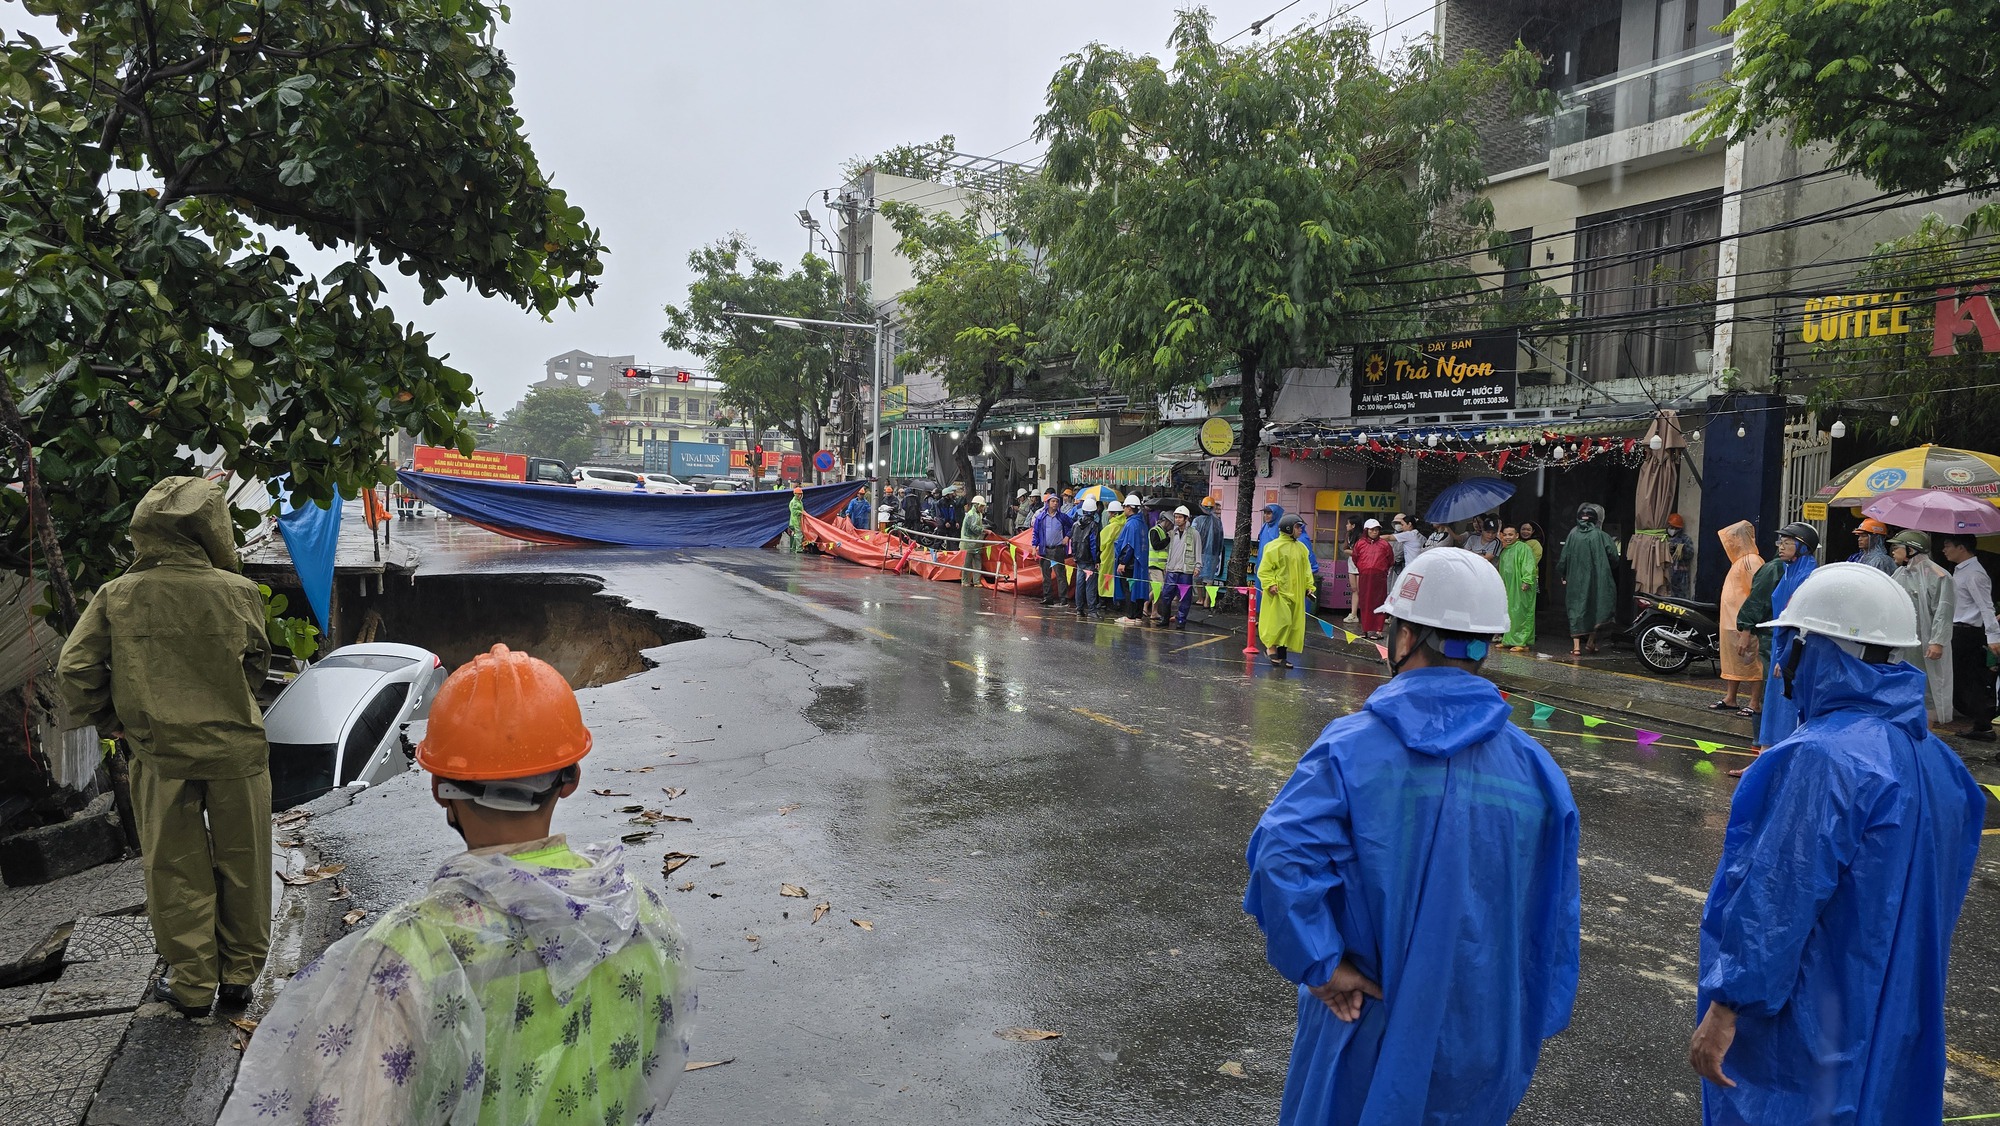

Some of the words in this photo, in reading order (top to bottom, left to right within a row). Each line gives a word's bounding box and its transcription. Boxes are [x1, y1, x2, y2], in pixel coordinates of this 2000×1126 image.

[1803, 292, 1910, 343] COFFEE
[678, 373, 689, 382] 31
[1394, 360, 1430, 381] Trà
[1436, 355, 1495, 384] Ngon
[1388, 391, 1400, 401] TRÀ
[1401, 391, 1414, 400] SỮA
[1419, 389, 1433, 399] TRÀ
[1434, 388, 1450, 398] TRÁI
[1451, 388, 1466, 397] CÂY
[1471, 385, 1493, 396] NƯỚC
[1494, 384, 1503, 394] ÉP
[1343, 492, 1365, 507] ĂN
[1657, 602, 1686, 616] DQTV
